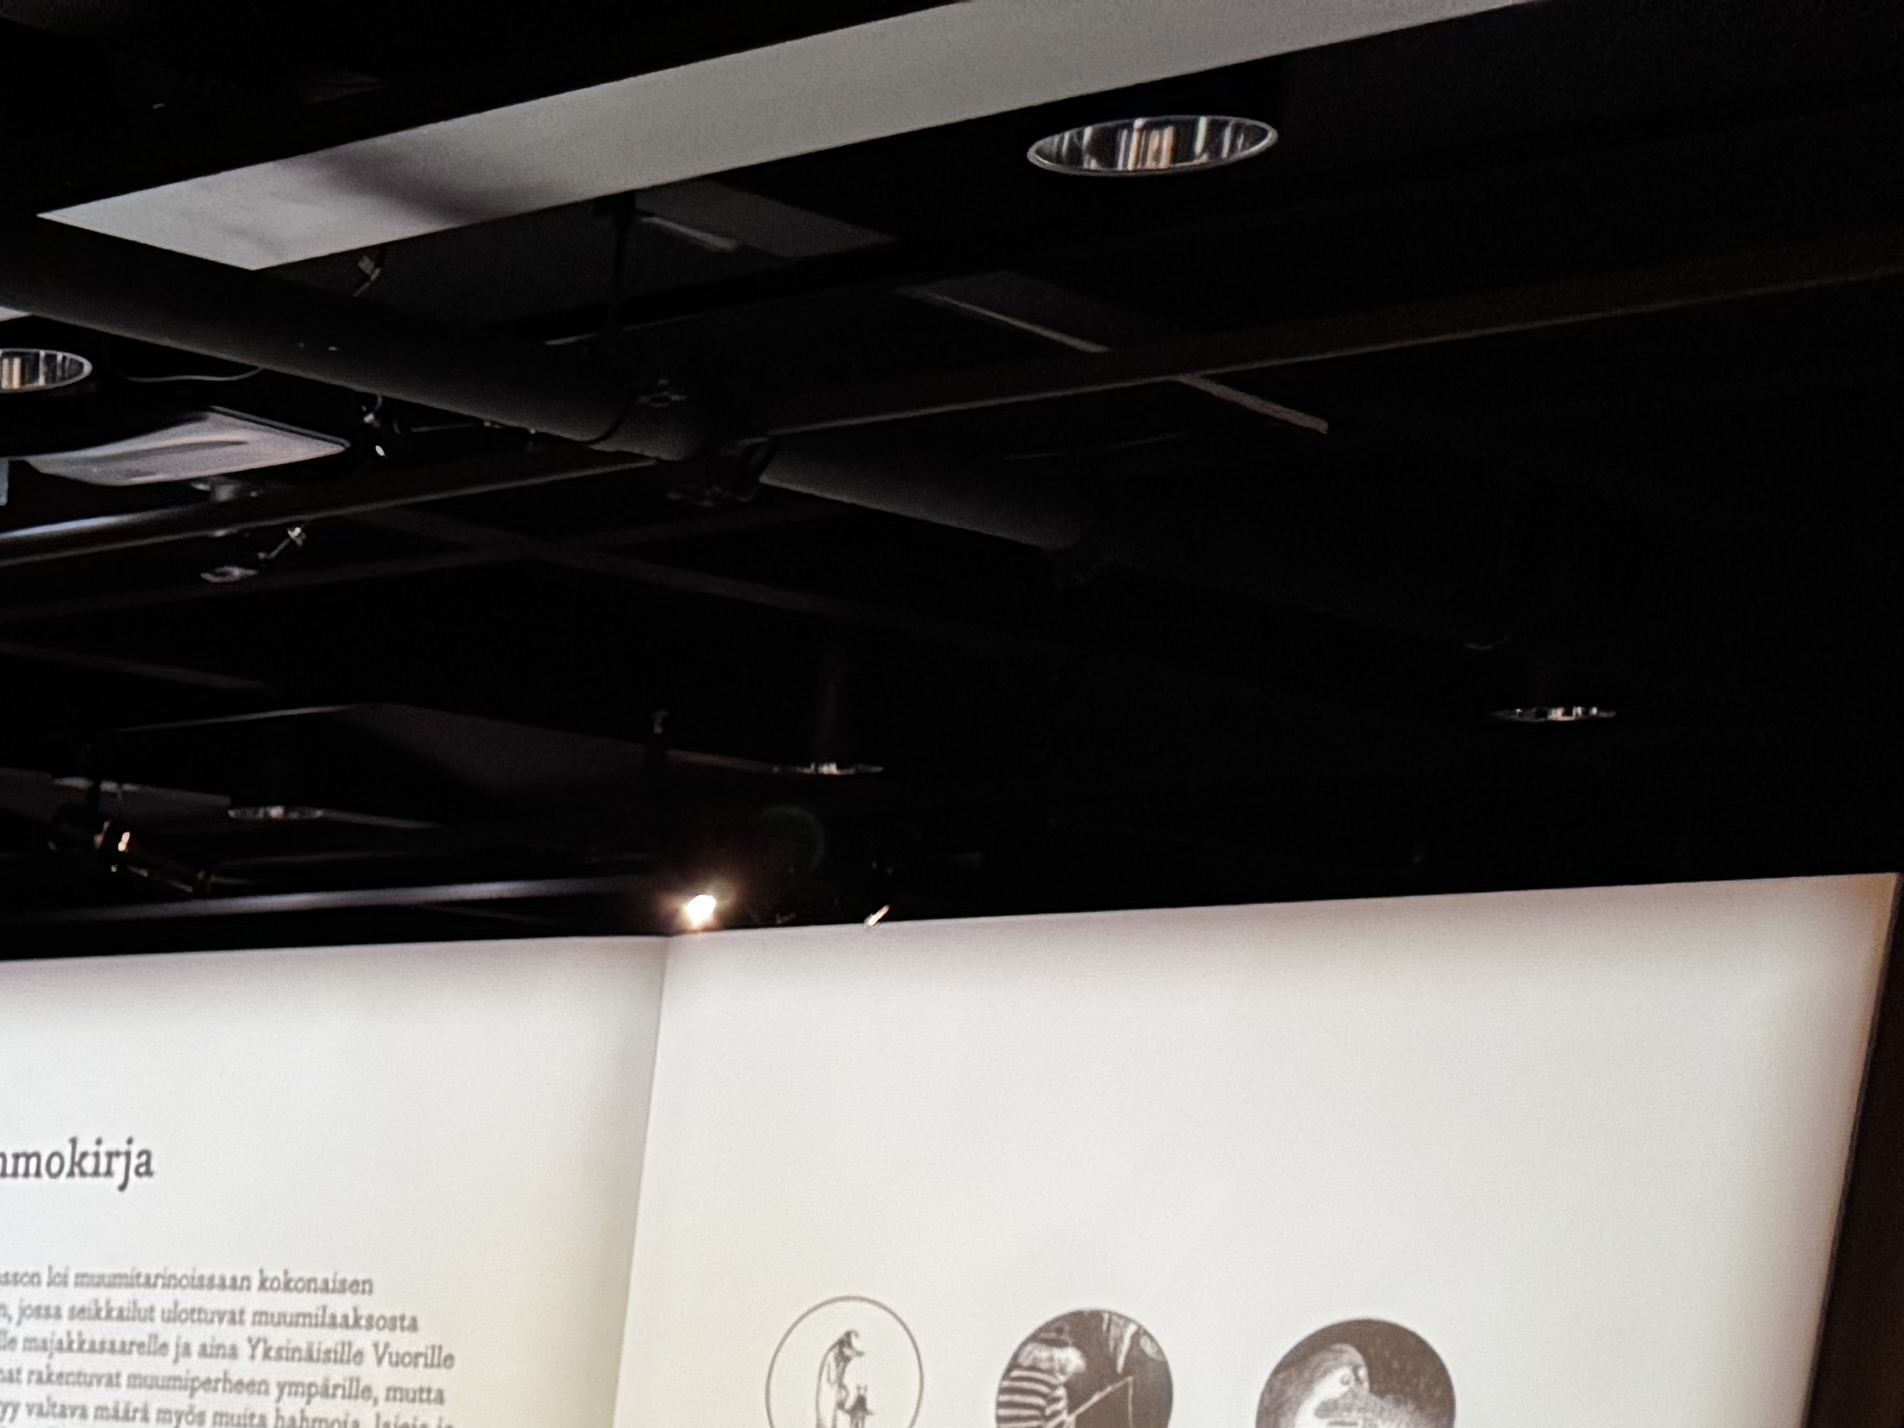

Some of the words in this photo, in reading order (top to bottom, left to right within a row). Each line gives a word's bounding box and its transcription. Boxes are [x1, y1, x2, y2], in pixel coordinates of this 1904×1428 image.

[47, 1265, 68, 1288] loi
[74, 1267, 251, 1292] muumitarinoissaan
[258, 1268, 374, 1296] kokonaisen
[16, 1299, 61, 1326] jossa
[68, 1298, 154, 1323] seikkailut
[161, 1300, 245, 1327] ulottuvat
[251, 1305, 418, 1333] muumilaaksosta
[22, 1328, 168, 1359] majakkasaarelle
[174, 1335, 192, 1364] ja
[198, 1336, 239, 1361] aina
[247, 1337, 364, 1366] Yksinäisille
[373, 1342, 455, 1369] Vuorille
[27, 1363, 121, 1388] rakentuvat
[127, 1370, 269, 1399] muumiperheen
[276, 1376, 378, 1406] ympärille,
[384, 1384, 446, 1405] mutta
[25, 1396, 88, 1420] valtava
[93, 1401, 150, 1423] määrä
